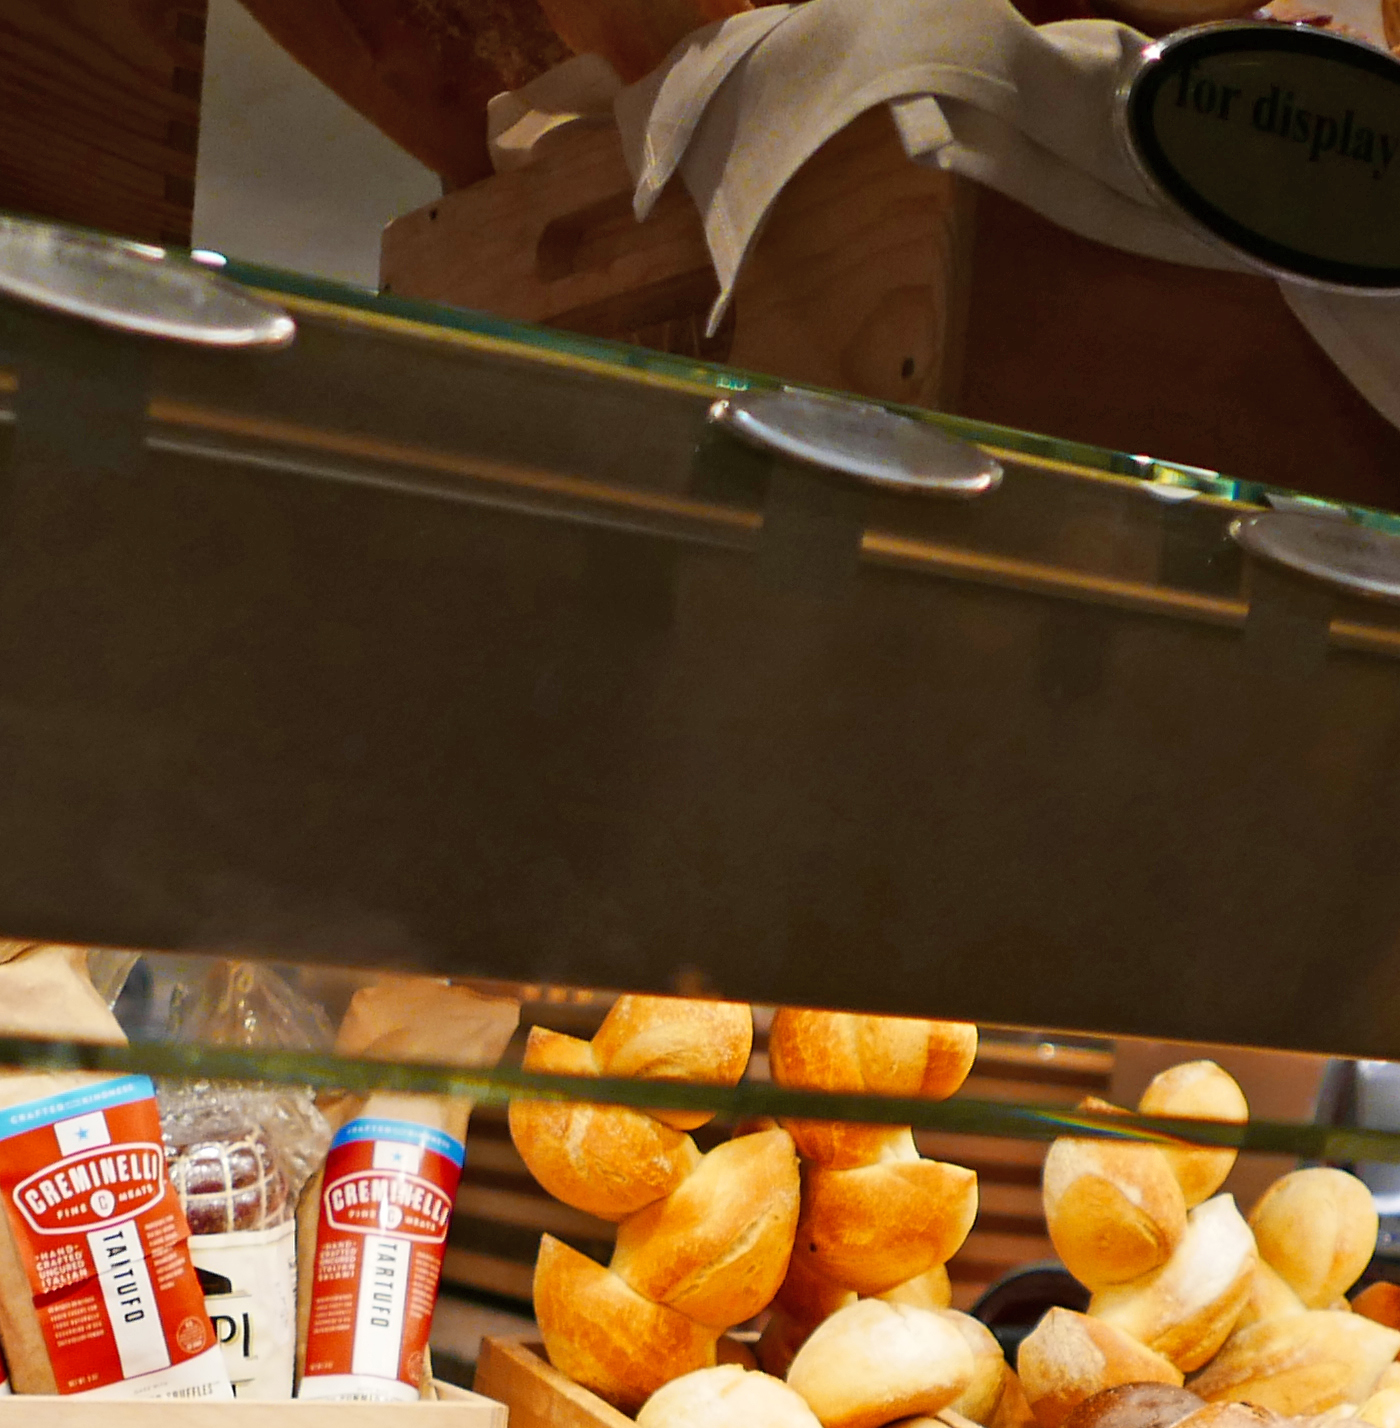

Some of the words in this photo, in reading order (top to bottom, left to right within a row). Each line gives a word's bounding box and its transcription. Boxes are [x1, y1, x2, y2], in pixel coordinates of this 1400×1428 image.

[1174, 63, 1242, 121] for
[1253, 82, 1399, 181] display
[25, 1153, 158, 1215] CREMINELLI
[56, 1202, 88, 1220] FINE
[118, 1183, 154, 1202] MEATS
[331, 1178, 450, 1227] CREMINELLI
[370, 1242, 398, 1328] TARTUFO
